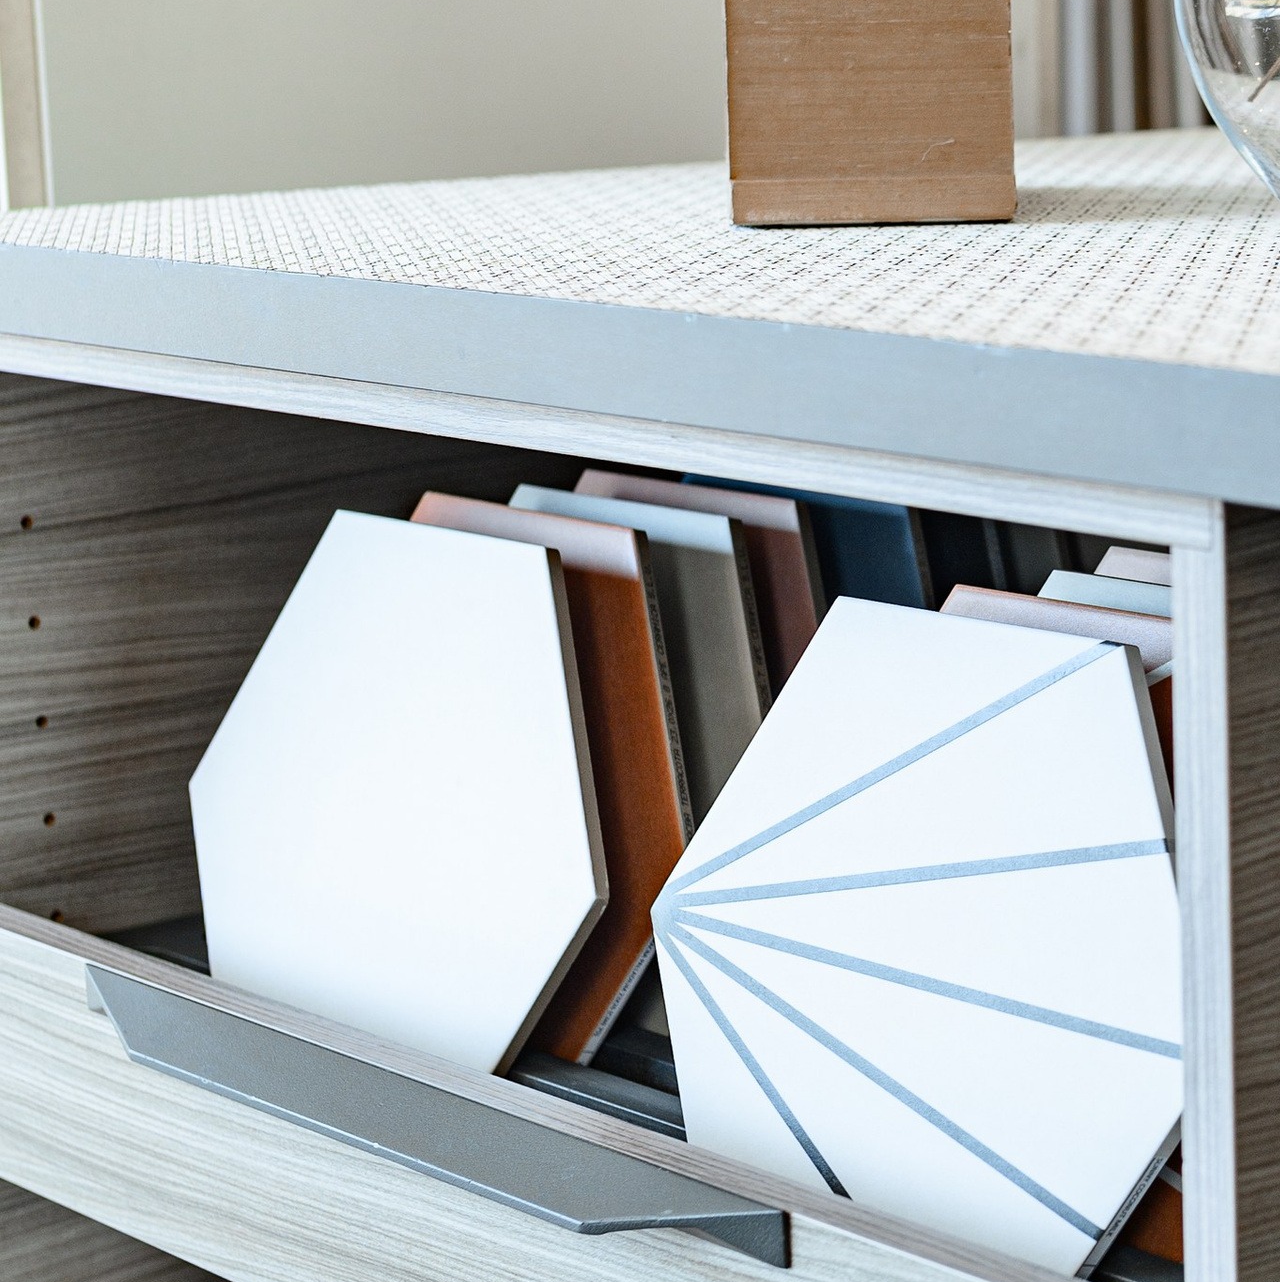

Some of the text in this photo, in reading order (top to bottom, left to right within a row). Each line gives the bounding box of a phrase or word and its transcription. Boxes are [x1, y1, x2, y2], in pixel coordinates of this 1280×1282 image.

[649, 603, 664, 656] CERAMICA
[672, 748, 689, 806] TERRACOTA
[1105, 1155, 1163, 1238] SUNNY COCONUT MILK
